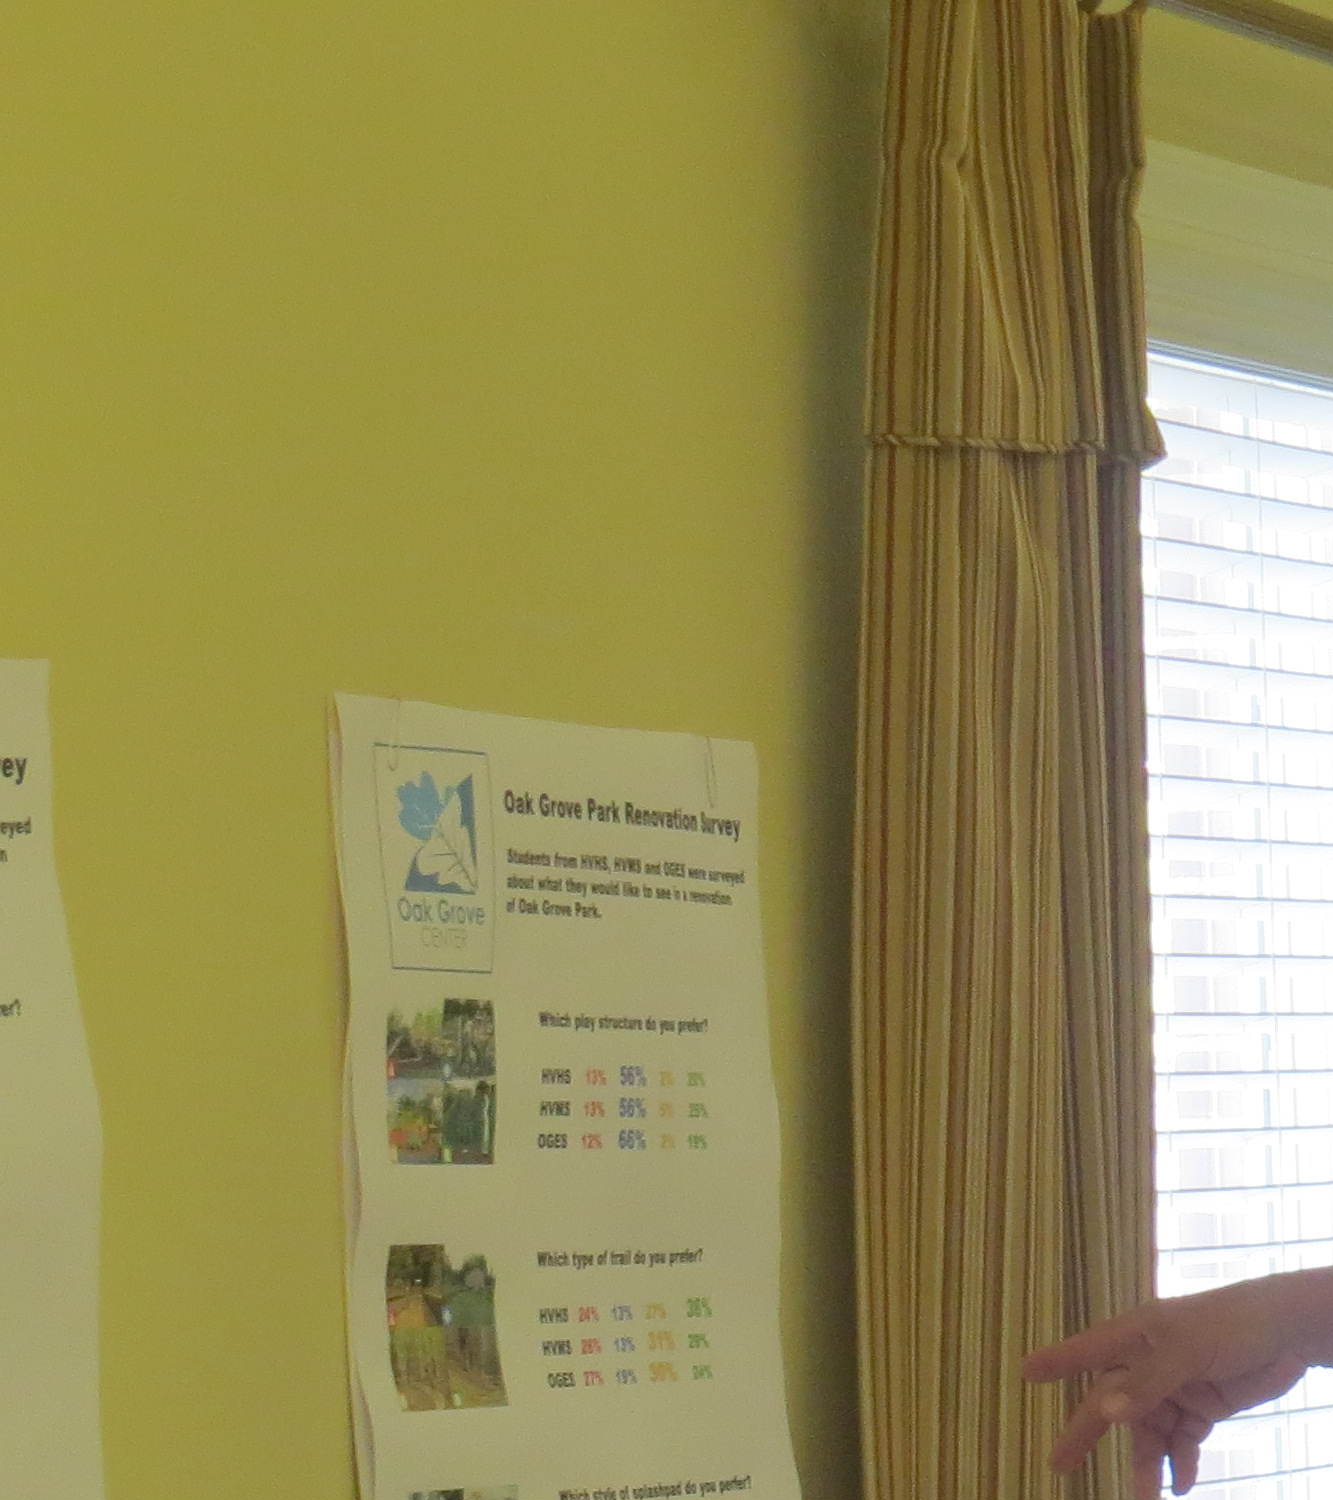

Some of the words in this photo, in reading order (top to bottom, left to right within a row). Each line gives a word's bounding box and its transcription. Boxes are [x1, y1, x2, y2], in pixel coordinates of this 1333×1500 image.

[503, 788, 536, 816] Oak
[539, 792, 583, 820] Grove
[586, 797, 621, 825] Park
[624, 801, 698, 833] Renovation
[699, 811, 741, 842] Survey
[506, 848, 552, 868] Students
[553, 851, 578, 868] from
[644, 861, 662, 875] and
[707, 871, 746, 886] surveyed
[506, 874, 535, 889] about
[537, 876, 563, 891] what
[565, 878, 588, 897] they
[590, 880, 620, 896] would
[622, 882, 641, 898] like
[642, 884, 654, 899] to
[656, 887, 672, 900] see
[398, 896, 432, 923] Oak
[437, 898, 486, 926] Grove
[506, 898, 517, 913] of
[518, 898, 539, 915] Oak
[541, 899, 573, 917] Grove
[538, 1012, 572, 1029] Which
[574, 1013, 596, 1033] play
[598, 1014, 643, 1032] structure
[645, 1015, 657, 1032] do
[659, 1020, 676, 1036] you
[677, 1016, 709, 1036] prefer?
[541, 1067, 572, 1085] HVHS
[619, 1064, 648, 1087] 56%
[539, 1100, 571, 1117] HVMS
[618, 1096, 648, 1118] 56%
[537, 1133, 568, 1150] OGES
[536, 1250, 570, 1268] Which
[572, 1251, 594, 1270] type
[597, 1249, 608, 1266] of
[610, 1249, 632, 1266] trail
[633, 1248, 647, 1265] do
[648, 1251, 667, 1268] you
[669, 1247, 704, 1268] prefer?
[538, 1307, 569, 1323] HVHS
[541, 1339, 573, 1356] HVMS
[546, 1372, 577, 1388] OGES
[619, 1485, 630, 1500] of
[684, 1479, 697, 1495] do
[699, 1480, 717, 1498] you
